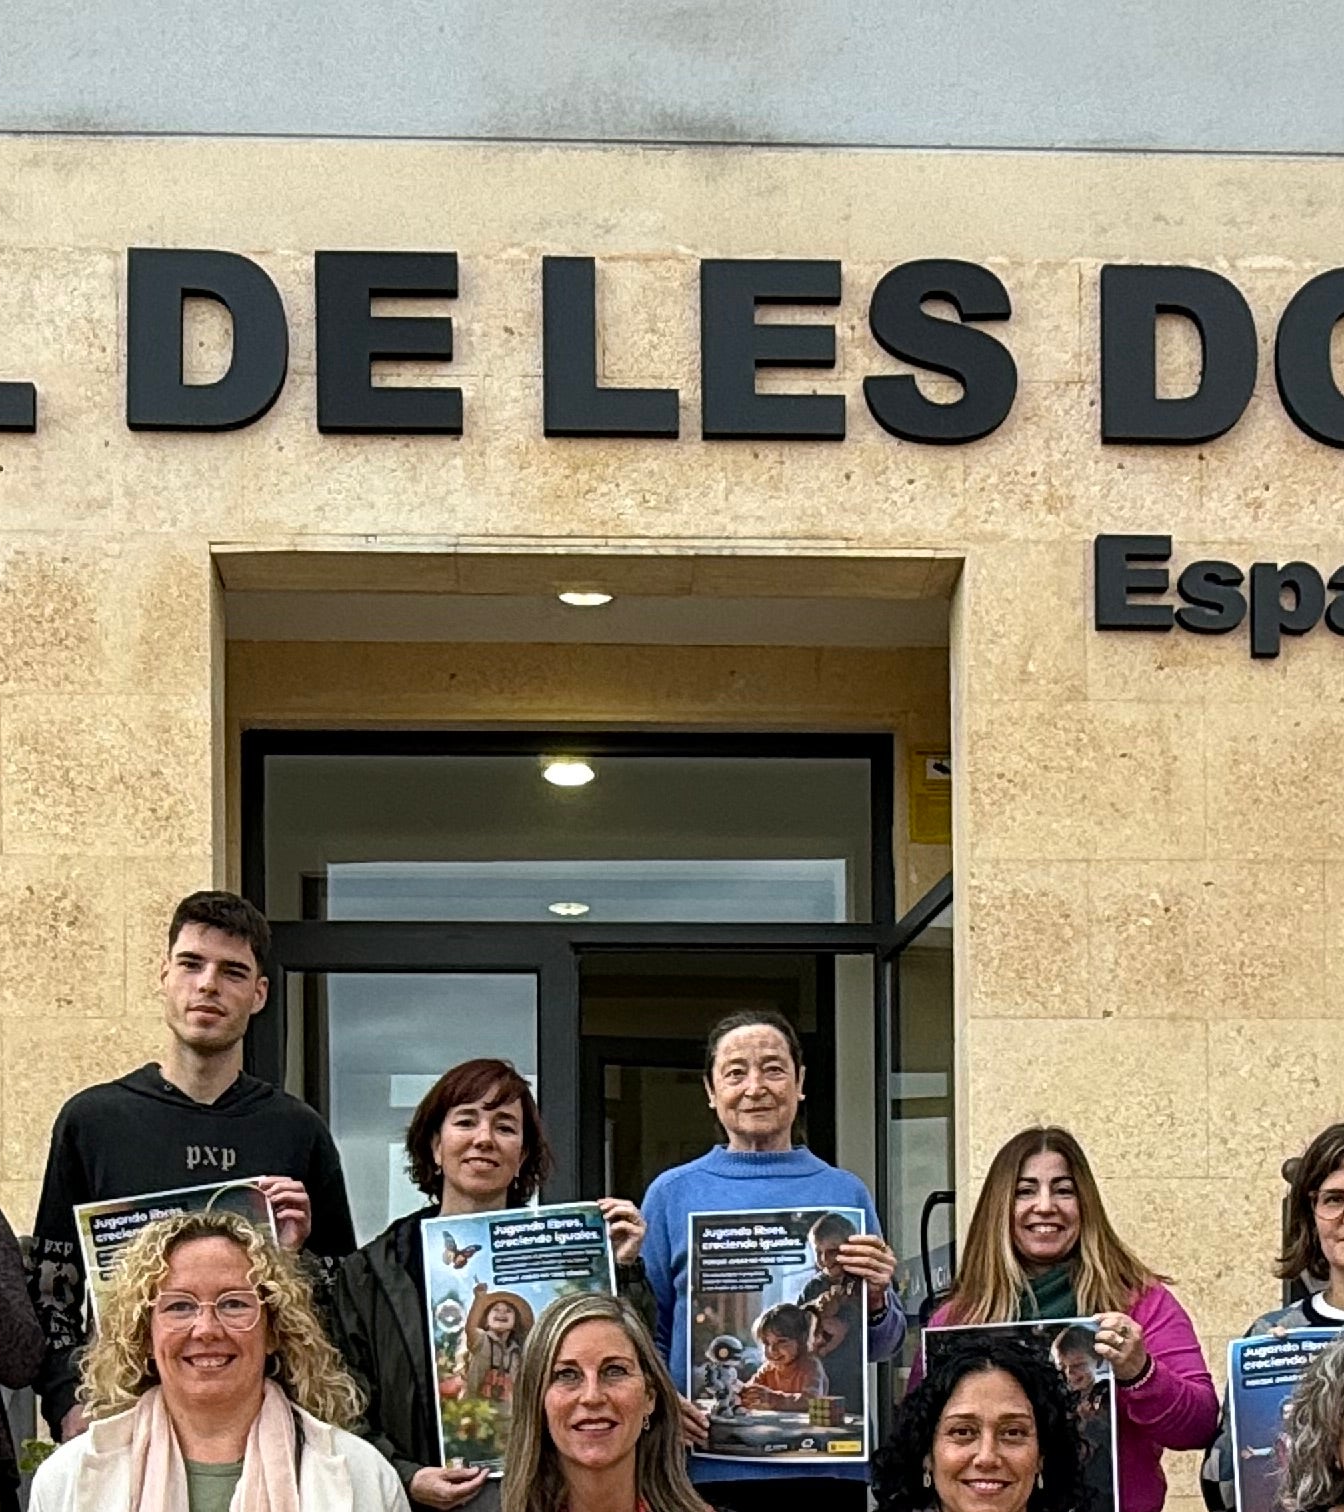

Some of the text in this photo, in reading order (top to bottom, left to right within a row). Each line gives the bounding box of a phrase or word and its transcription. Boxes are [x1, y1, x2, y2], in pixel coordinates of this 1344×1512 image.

[126, 246, 464, 435] DE
[542, 255, 1019, 446] LES
[186, 1145, 237, 1171] pxp
